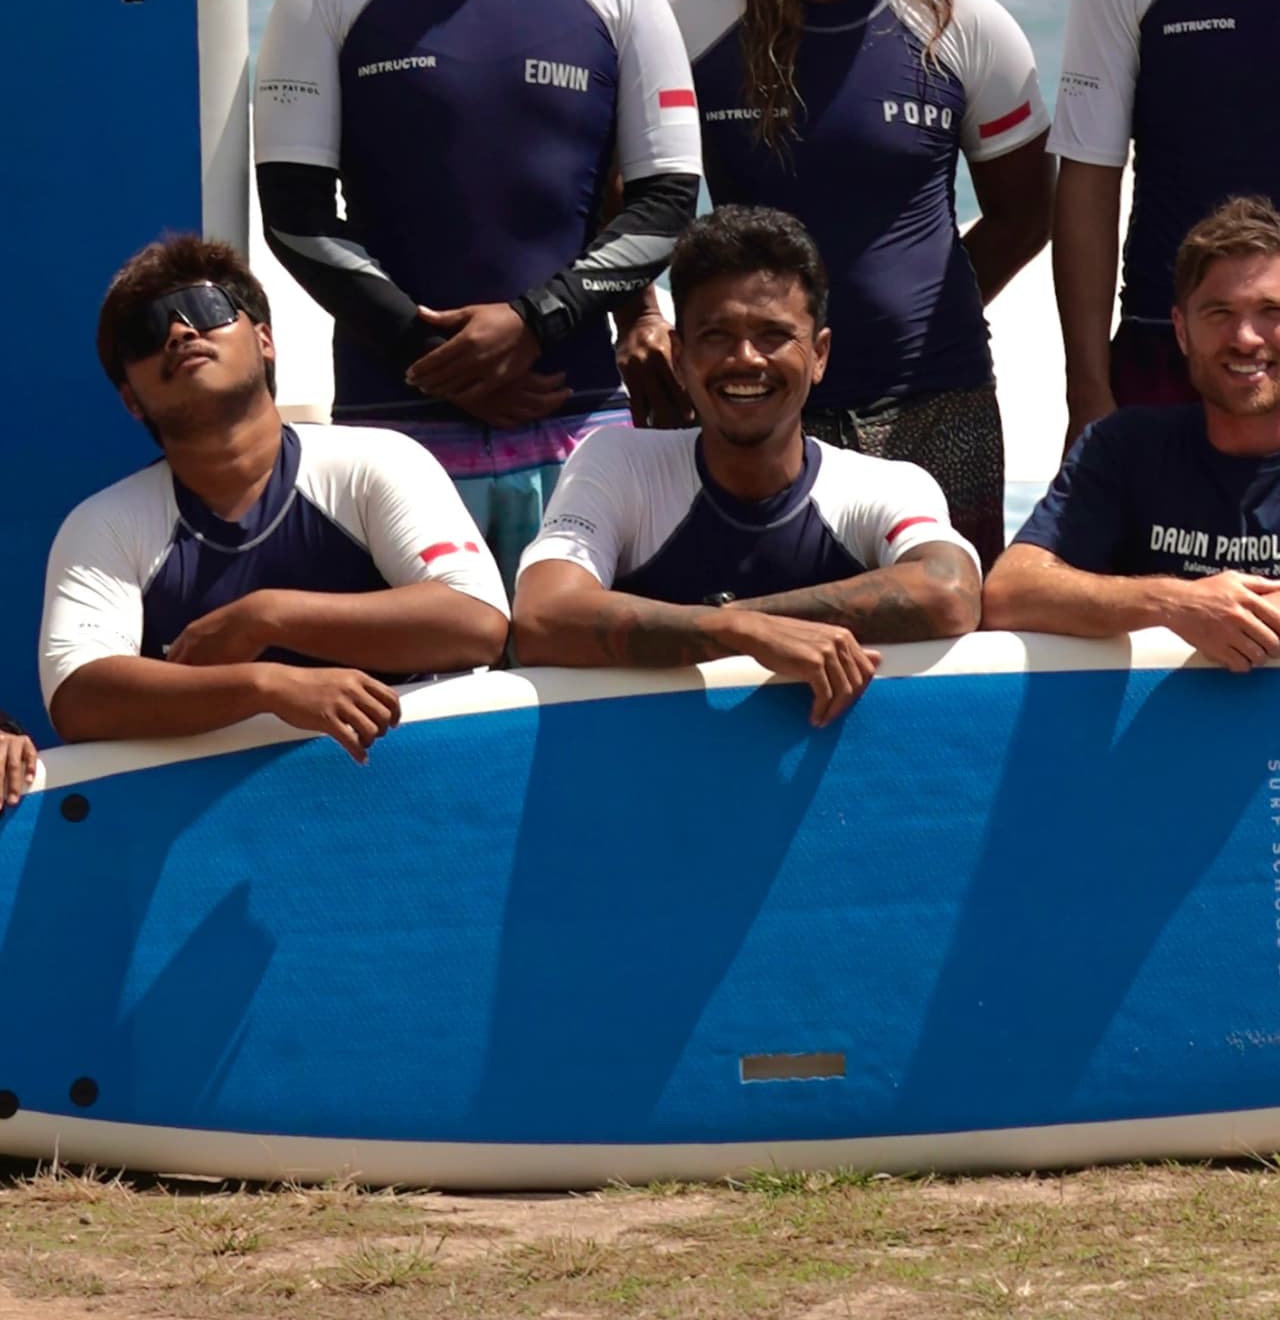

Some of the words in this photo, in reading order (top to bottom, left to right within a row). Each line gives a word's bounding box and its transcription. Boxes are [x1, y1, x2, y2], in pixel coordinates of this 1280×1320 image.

[1163, 17, 1236, 36] INSTRUCTOR
[357, 55, 437, 77] INSTRUCTOR
[524, 58, 589, 92] EDWIN
[705, 108, 790, 121] INSTRUCOR
[883, 100, 953, 129] POPO
[1149, 524, 1209, 558] DAWN
